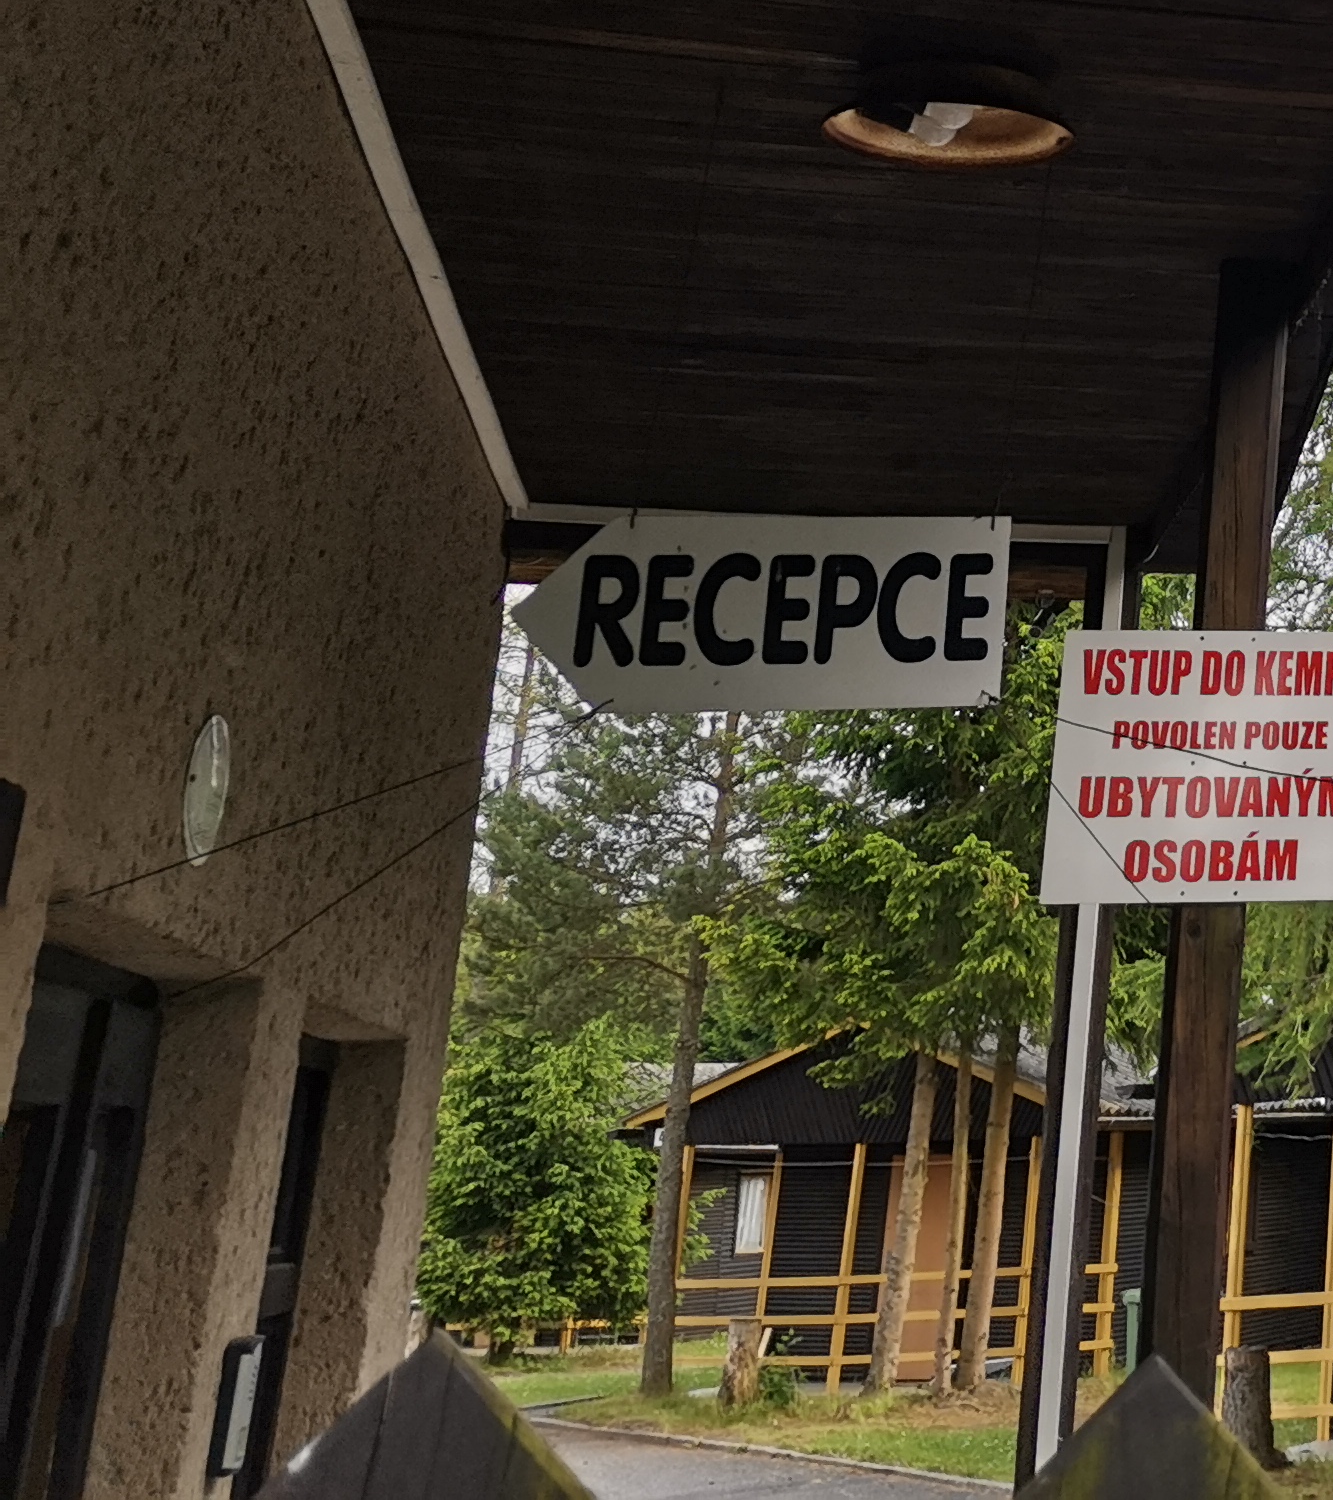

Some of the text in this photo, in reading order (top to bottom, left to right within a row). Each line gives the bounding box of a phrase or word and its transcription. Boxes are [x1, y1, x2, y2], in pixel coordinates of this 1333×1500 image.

[572, 551, 995, 667] RECEPCE
[1083, 649, 1193, 697] VSTUP
[1200, 649, 1247, 697] DO
[1111, 720, 1330, 751] POVOLEN POUZE
[1122, 830, 1299, 883] OSOBÁM
